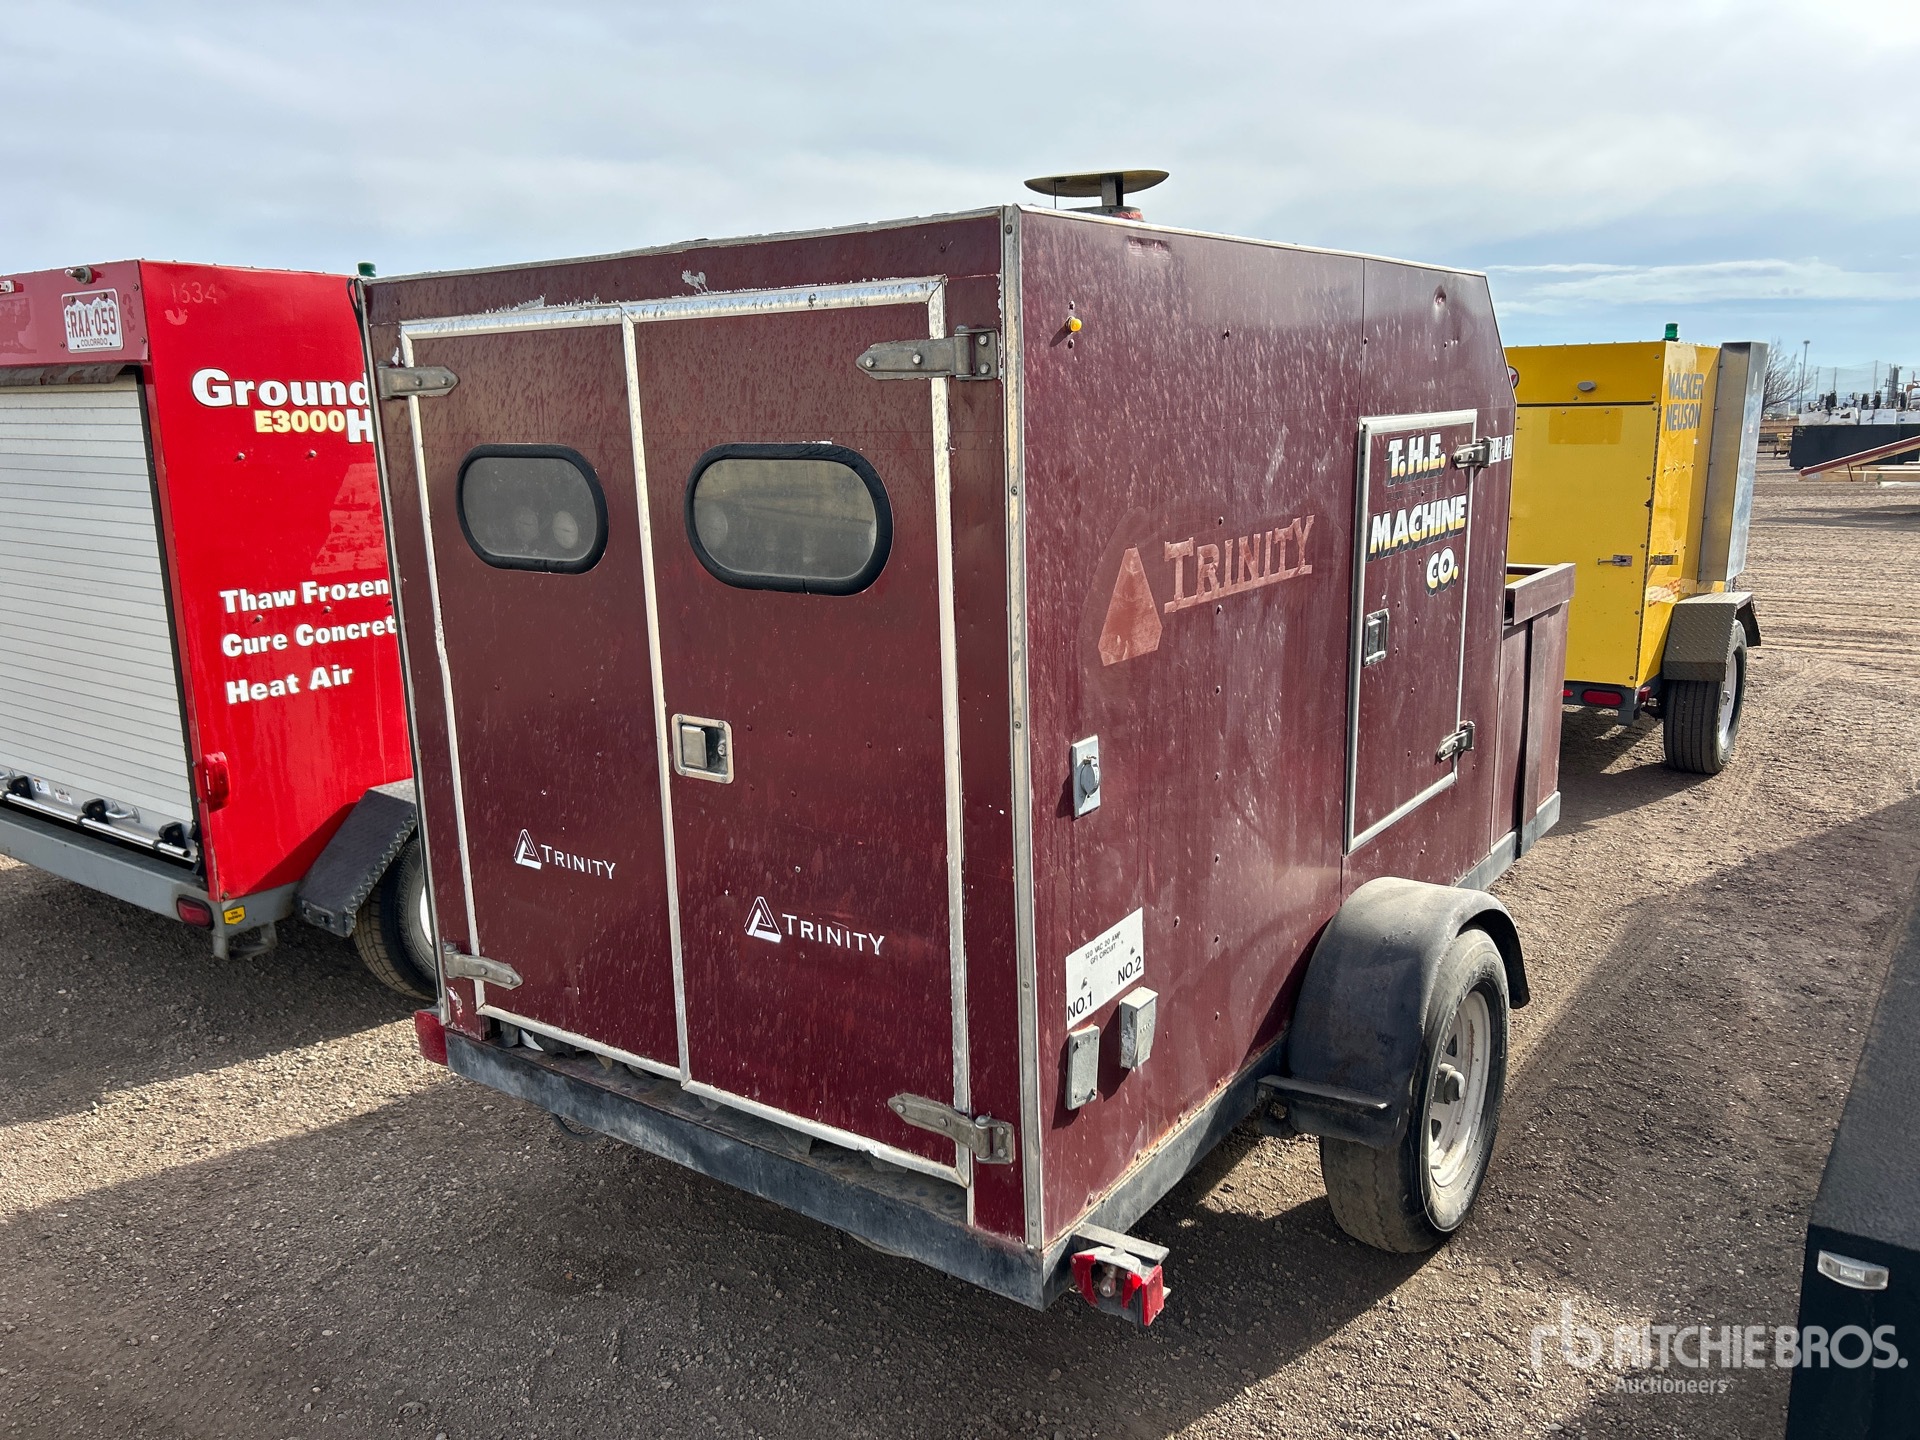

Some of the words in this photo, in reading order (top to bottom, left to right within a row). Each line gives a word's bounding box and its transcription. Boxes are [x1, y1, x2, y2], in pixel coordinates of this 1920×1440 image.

[80, 337, 108, 347] COLORADO
[191, 367, 370, 408] Ground
[1668, 372, 1705, 400] WACKER
[254, 409, 346, 433] E3000
[1665, 402, 1702, 431] NEUSON
[1387, 433, 1447, 482] T.H.E.
[1368, 494, 1467, 557] MACHINE
[1164, 514, 1315, 612] TRINITY
[1425, 546, 1459, 592] CO.
[219, 587, 298, 614] Thaw
[301, 577, 390, 605] Frozen
[221, 631, 289, 659] Cure
[225, 672, 301, 705] Heat
[308, 663, 354, 692] Air
[540, 844, 616, 880] TRINITY
[782, 913, 886, 955] TRINITY
[1099, 942, 1117, 959] CIRCUIT
[1117, 955, 1142, 985] NO.2
[1067, 990, 1092, 1021] NO.1
